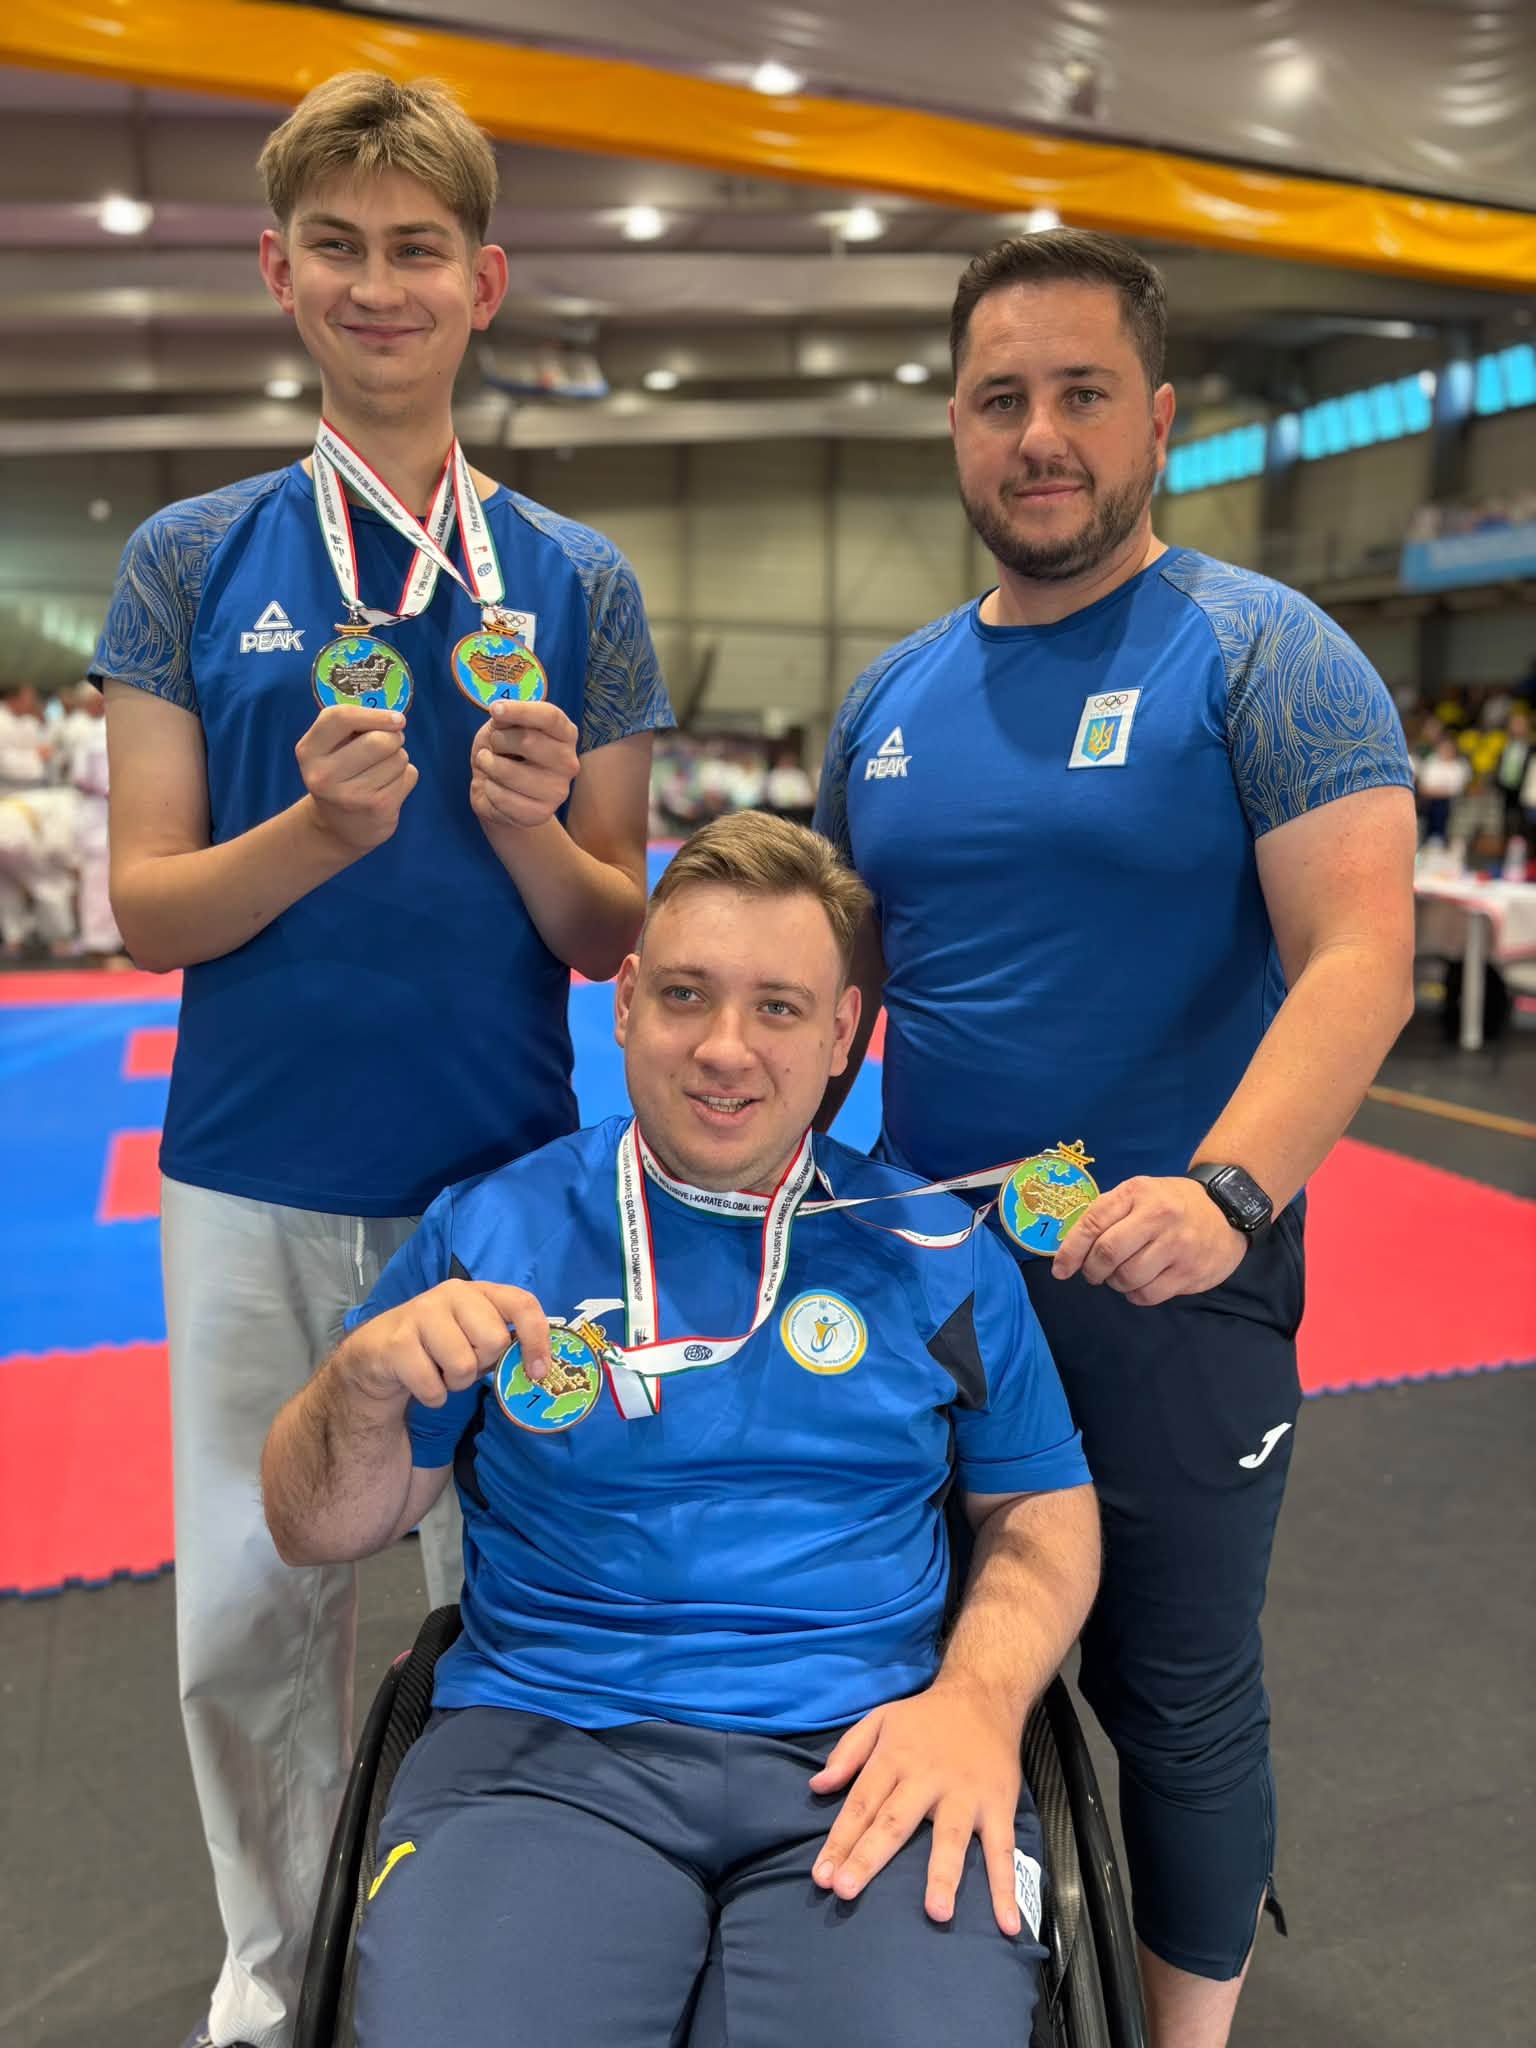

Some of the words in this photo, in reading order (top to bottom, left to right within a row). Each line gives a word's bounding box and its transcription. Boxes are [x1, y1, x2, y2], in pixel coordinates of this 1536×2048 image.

[240, 630, 305, 653] PEAK
[366, 697, 378, 709] 2
[864, 756, 912, 780] PEAK
[690, 1193, 722, 1207] I-KARATE
[722, 1199, 751, 1211] GLOBAL
[625, 1200, 637, 1228] GLOBAL
[630, 1228, 640, 1253] WORLD
[1039, 1221, 1050, 1238] 1
[772, 1230, 783, 1270] INCLUSIVE
[526, 1394, 542, 1409] 1
